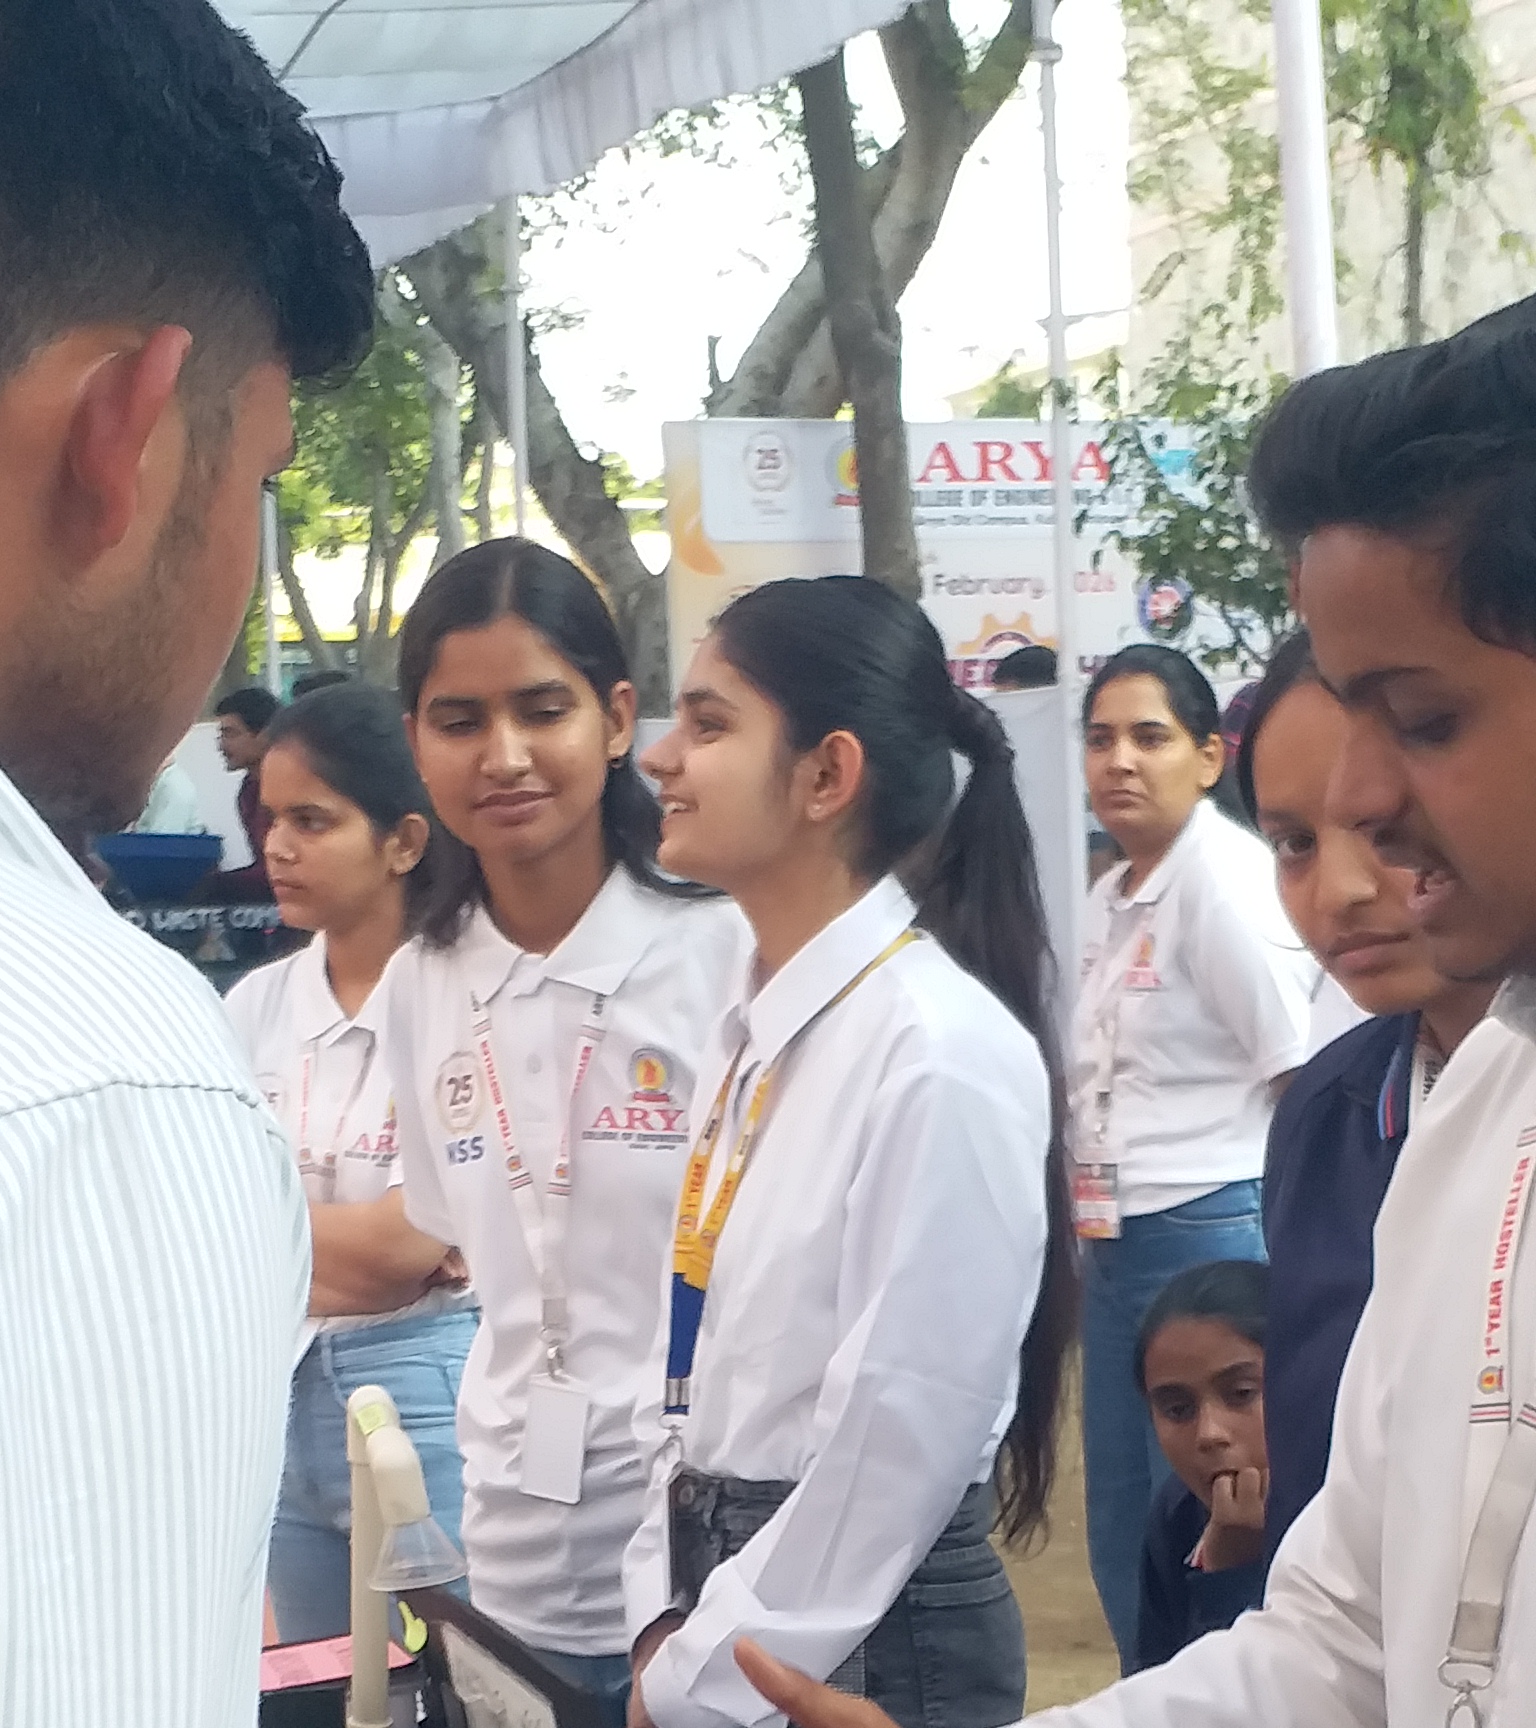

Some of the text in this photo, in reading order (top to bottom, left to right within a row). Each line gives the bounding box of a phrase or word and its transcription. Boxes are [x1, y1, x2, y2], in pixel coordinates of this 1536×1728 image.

[915, 440, 1111, 483] ARYA
[447, 1074, 473, 1107] 25
[591, 1105, 689, 1132] ARY
[351, 1133, 400, 1152] AR
[1493, 1156, 1531, 1271] HOSTELLER
[1486, 1279, 1505, 1335] YEAR
